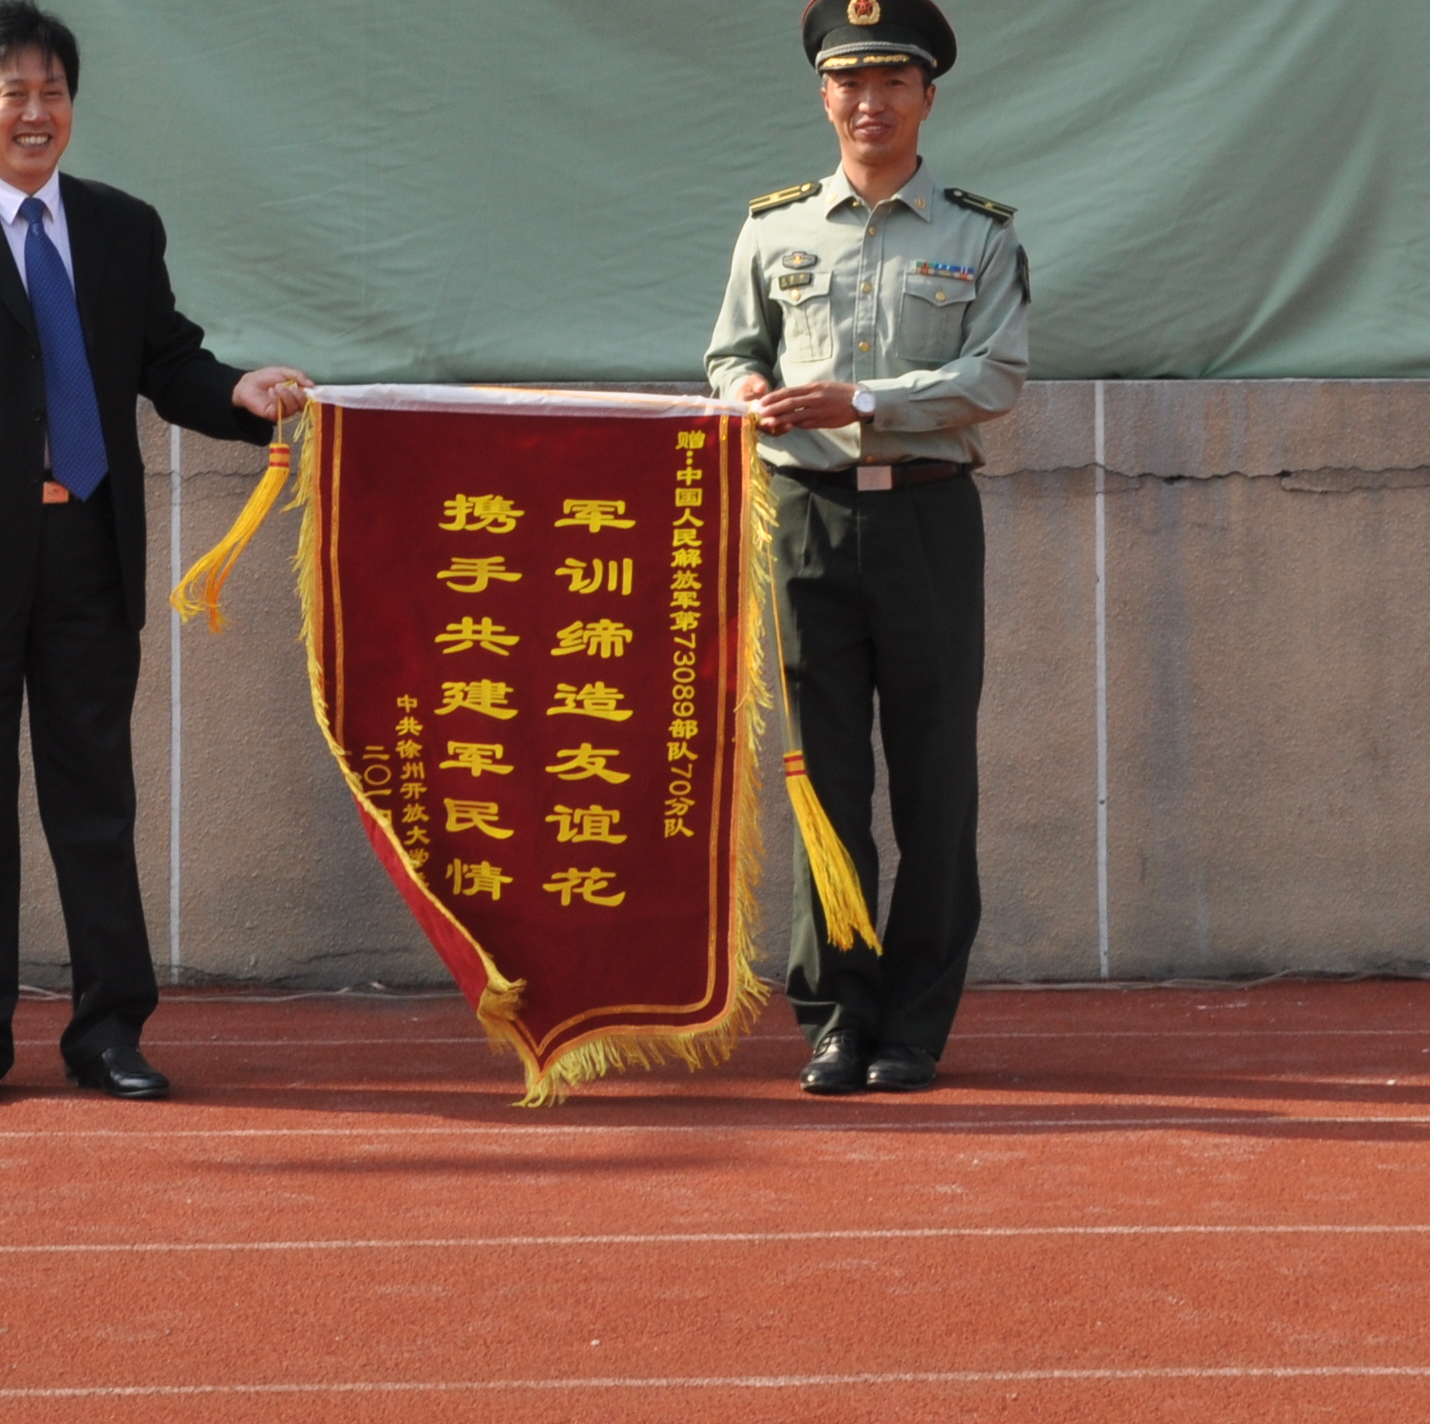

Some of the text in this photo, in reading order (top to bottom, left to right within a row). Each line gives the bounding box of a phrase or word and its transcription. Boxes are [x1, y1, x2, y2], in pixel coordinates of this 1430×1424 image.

[434, 493, 526, 902] 携手共建军民情
[542, 497, 637, 908] 军训缔造友谊花
